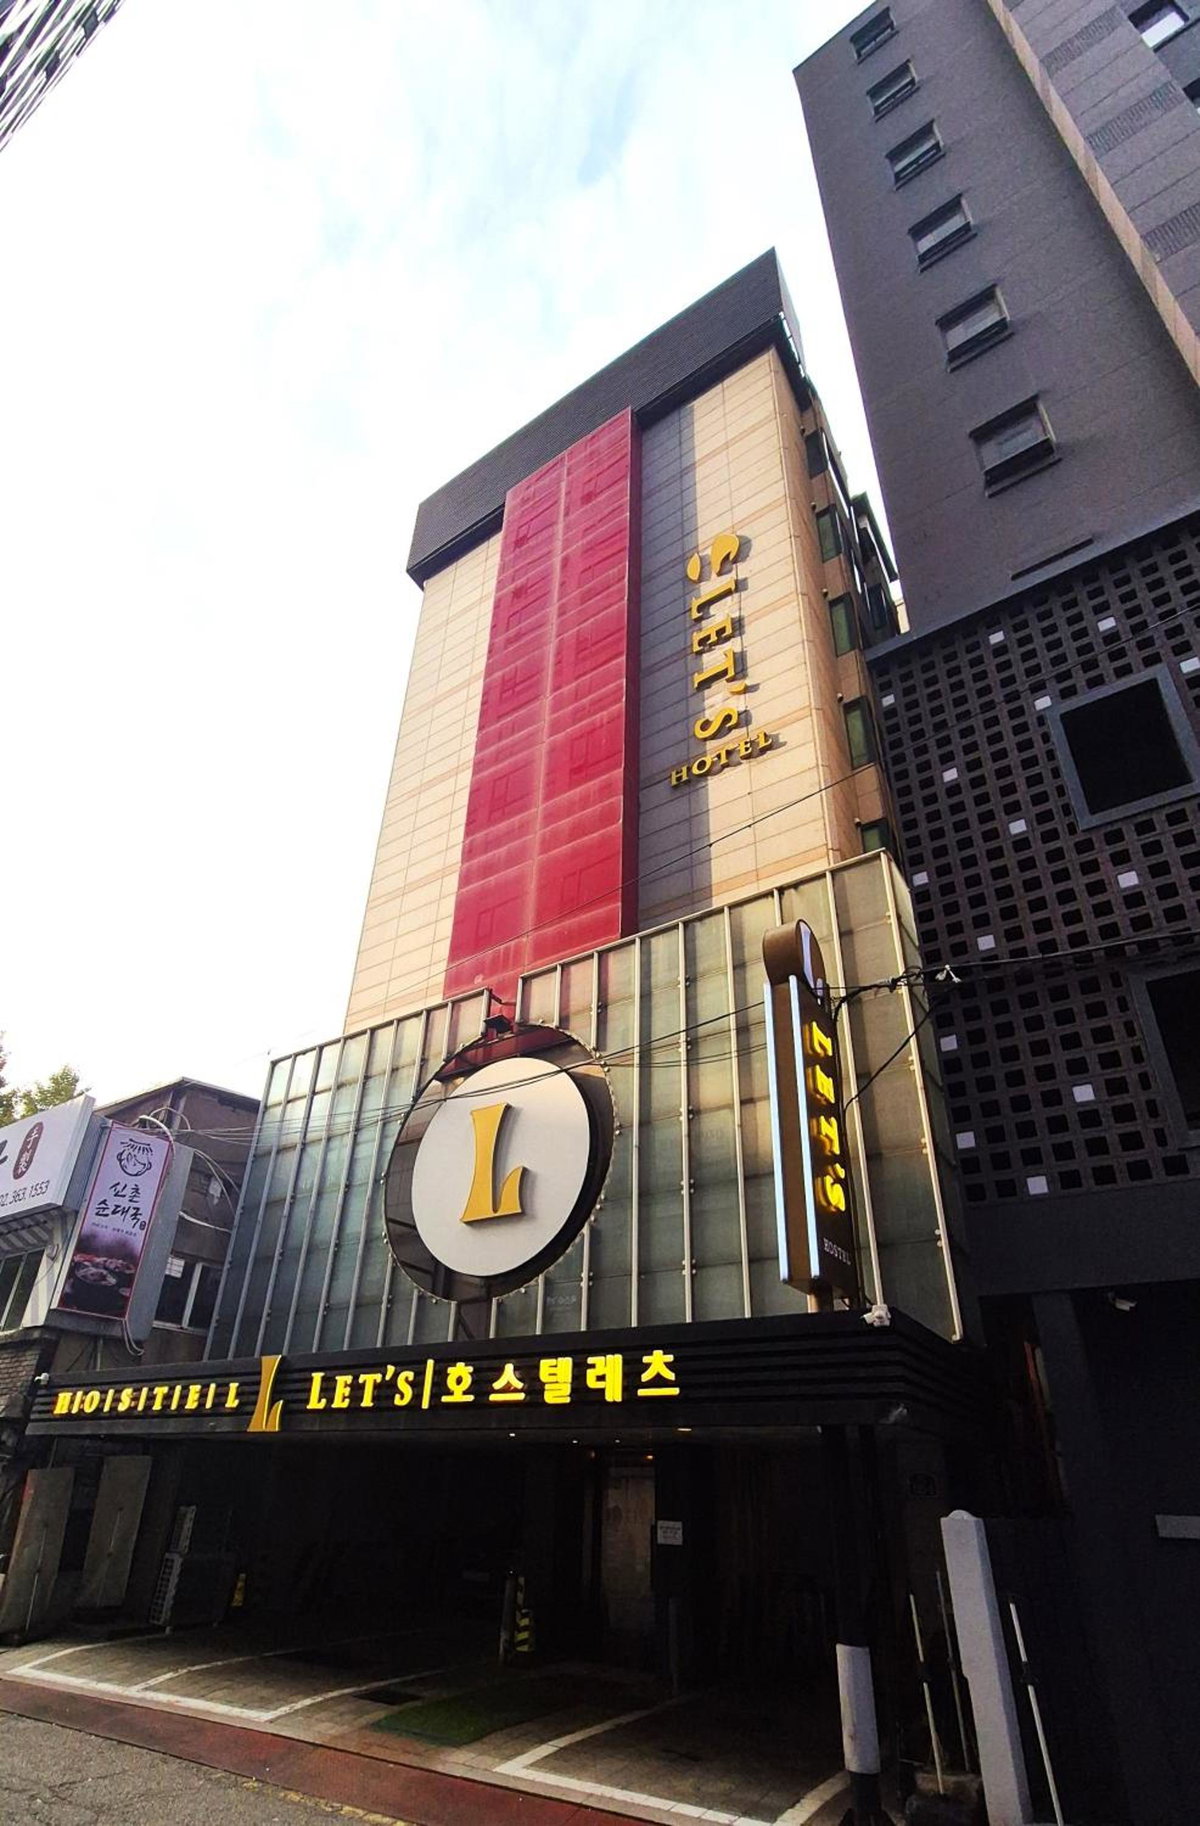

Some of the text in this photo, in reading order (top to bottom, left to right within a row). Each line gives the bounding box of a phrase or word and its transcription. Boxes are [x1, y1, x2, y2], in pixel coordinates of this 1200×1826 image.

[690, 576, 747, 740] LET'S
[670, 732, 773, 786] HOTEL
[811, 1021, 846, 1212] LET'S
[95, 1199, 142, 1229] 순대국
[109, 1181, 141, 1203] 신촌
[823, 1237, 851, 1265] HOSTEL
[306, 1365, 415, 1410] LET'S
[440, 1349, 681, 1405] 호스텔레츠
